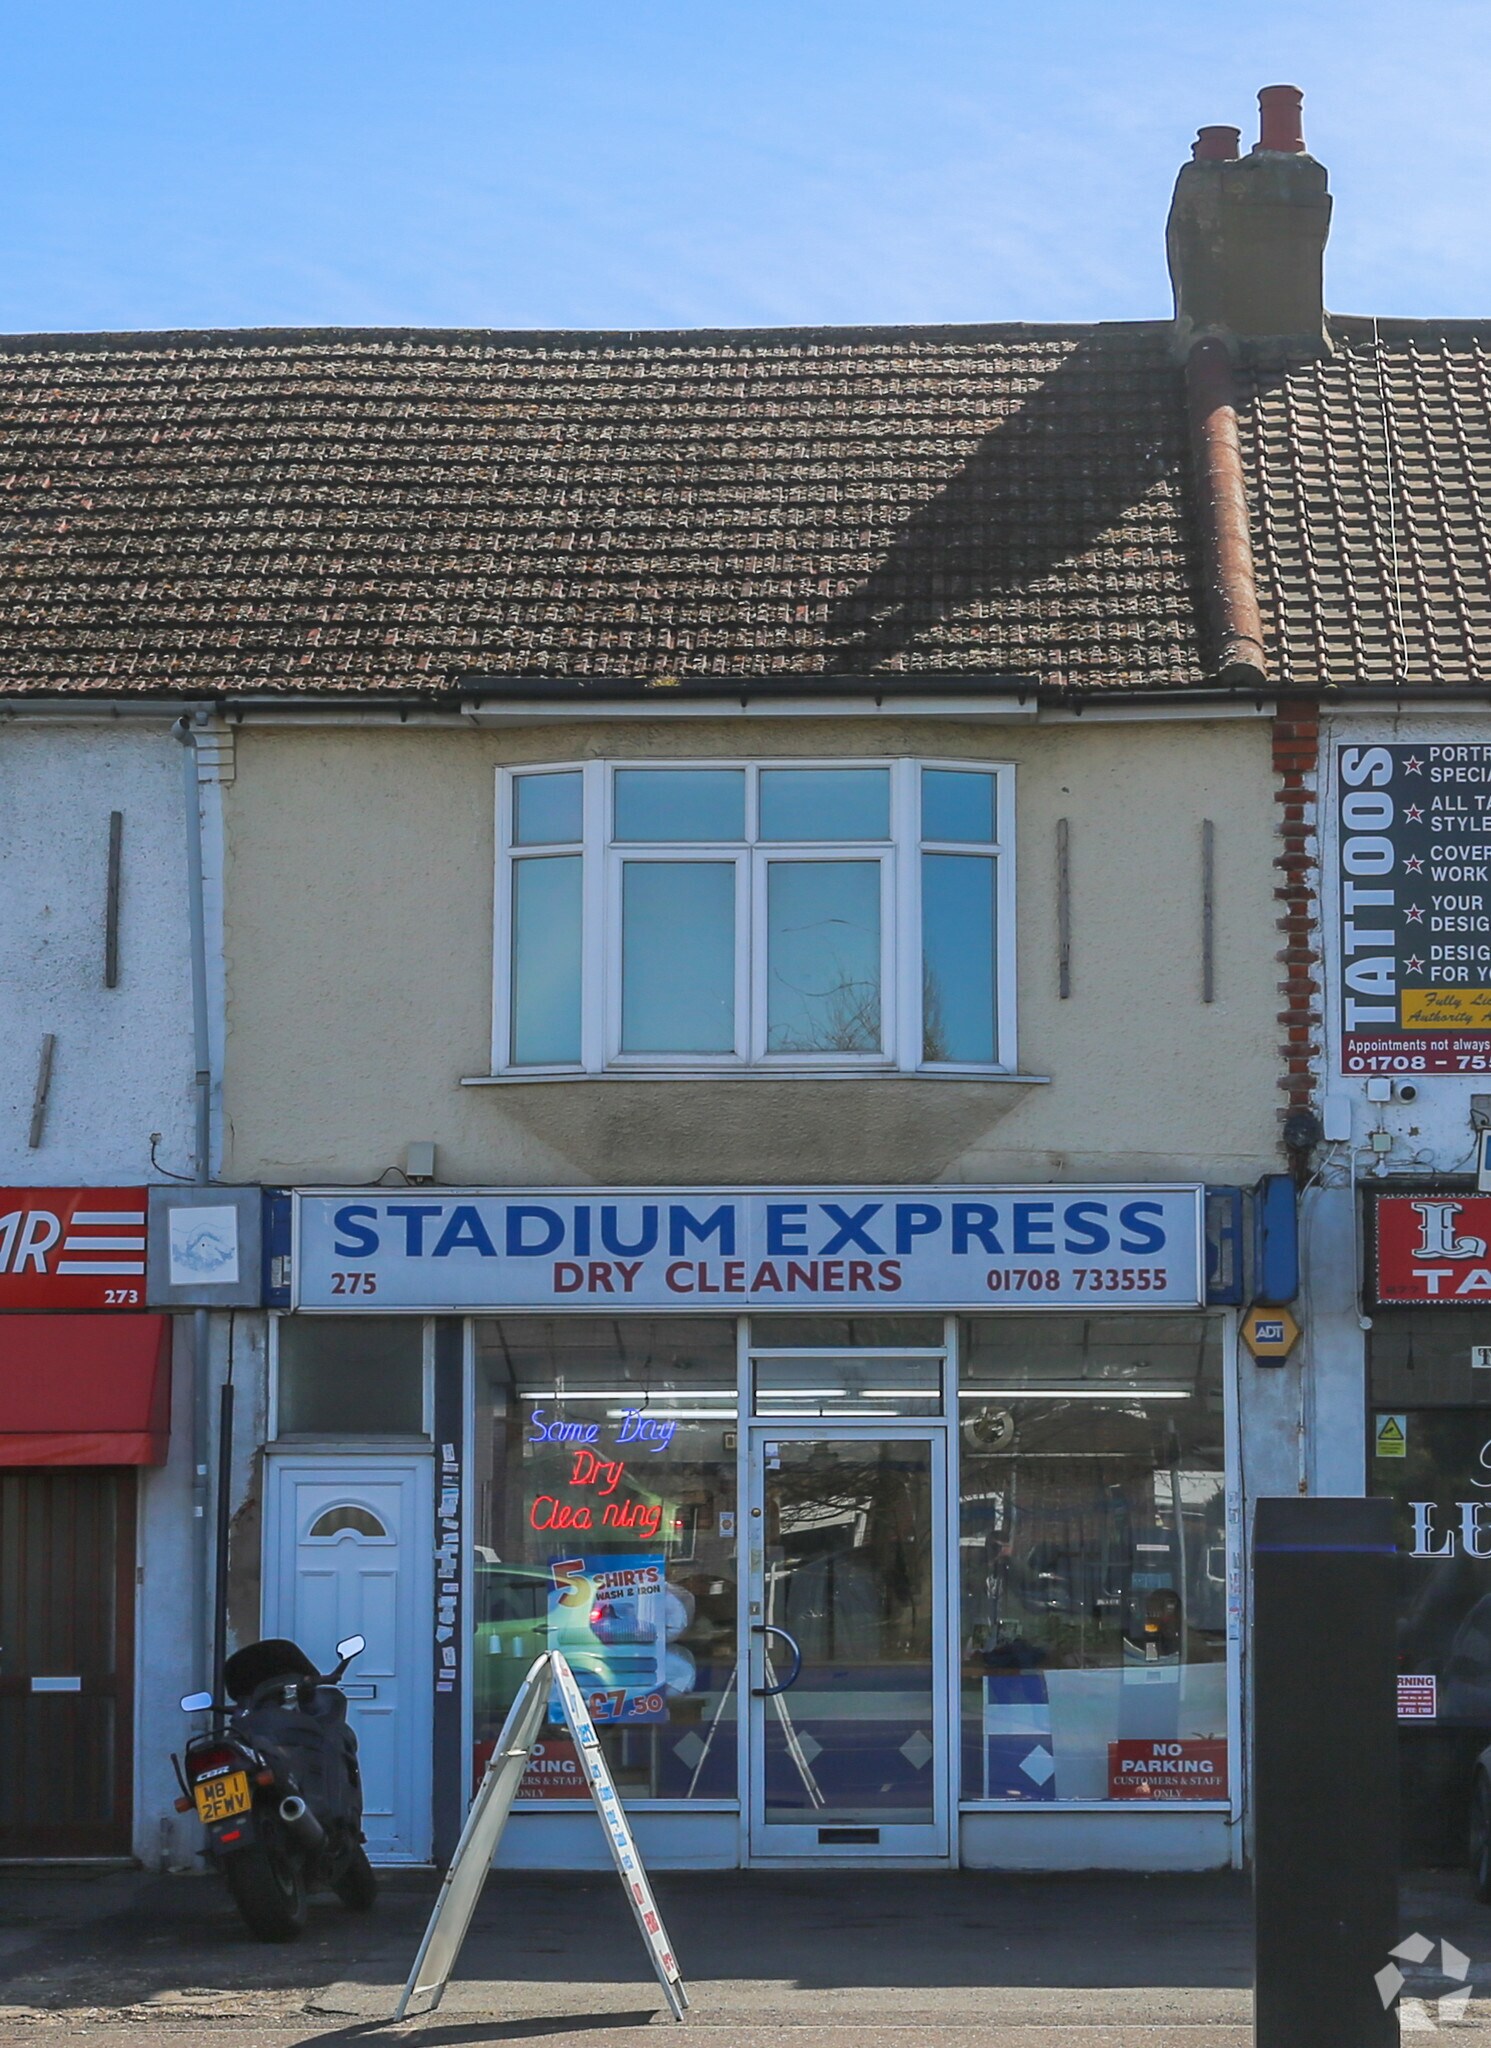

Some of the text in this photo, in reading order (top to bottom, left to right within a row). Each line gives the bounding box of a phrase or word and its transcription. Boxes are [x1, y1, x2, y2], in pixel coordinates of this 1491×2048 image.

[1431, 795, 1468, 811] ALL
[1430, 866, 1488, 882] WORK
[1341, 747, 1396, 1032] TATTOOS
[1431, 895, 1483, 911] YOUR
[1431, 966, 1469, 982] FOR
[1424, 992, 1462, 1009] Fully
[1407, 1009, 1473, 1025] Authority
[1348, 1038, 1490, 1054] Appointments not always
[1349, 1056, 1426, 1071] 01708
[1456, 1055, 1491, 1070] 75
[333, 1201, 1167, 1259] STADIUM EXPRESS
[330, 1272, 377, 1295] 275
[553, 1260, 902, 1293] DRY CLEANERS
[986, 1268, 1168, 1291] 01708 733555
[104, 1290, 139, 1304] 273
[1256, 1325, 1284, 1339] ADT
[528, 1407, 677, 1452] Same Day
[569, 1450, 624, 1495] Dry
[552, 1558, 660, 1608] 5 SHIRTS
[595, 1590, 624, 1601] WASH
[637, 1584, 661, 1595] IRON
[1152, 1743, 1183, 1756] NO
[1121, 1760, 1214, 1773] PARKING
[552, 1776, 585, 1786] STAFF
[1113, 1776, 1178, 1786] CUSTOMERS
[1191, 1776, 1223, 1786] STAFF
[1153, 1788, 1183, 1798] ONLY
